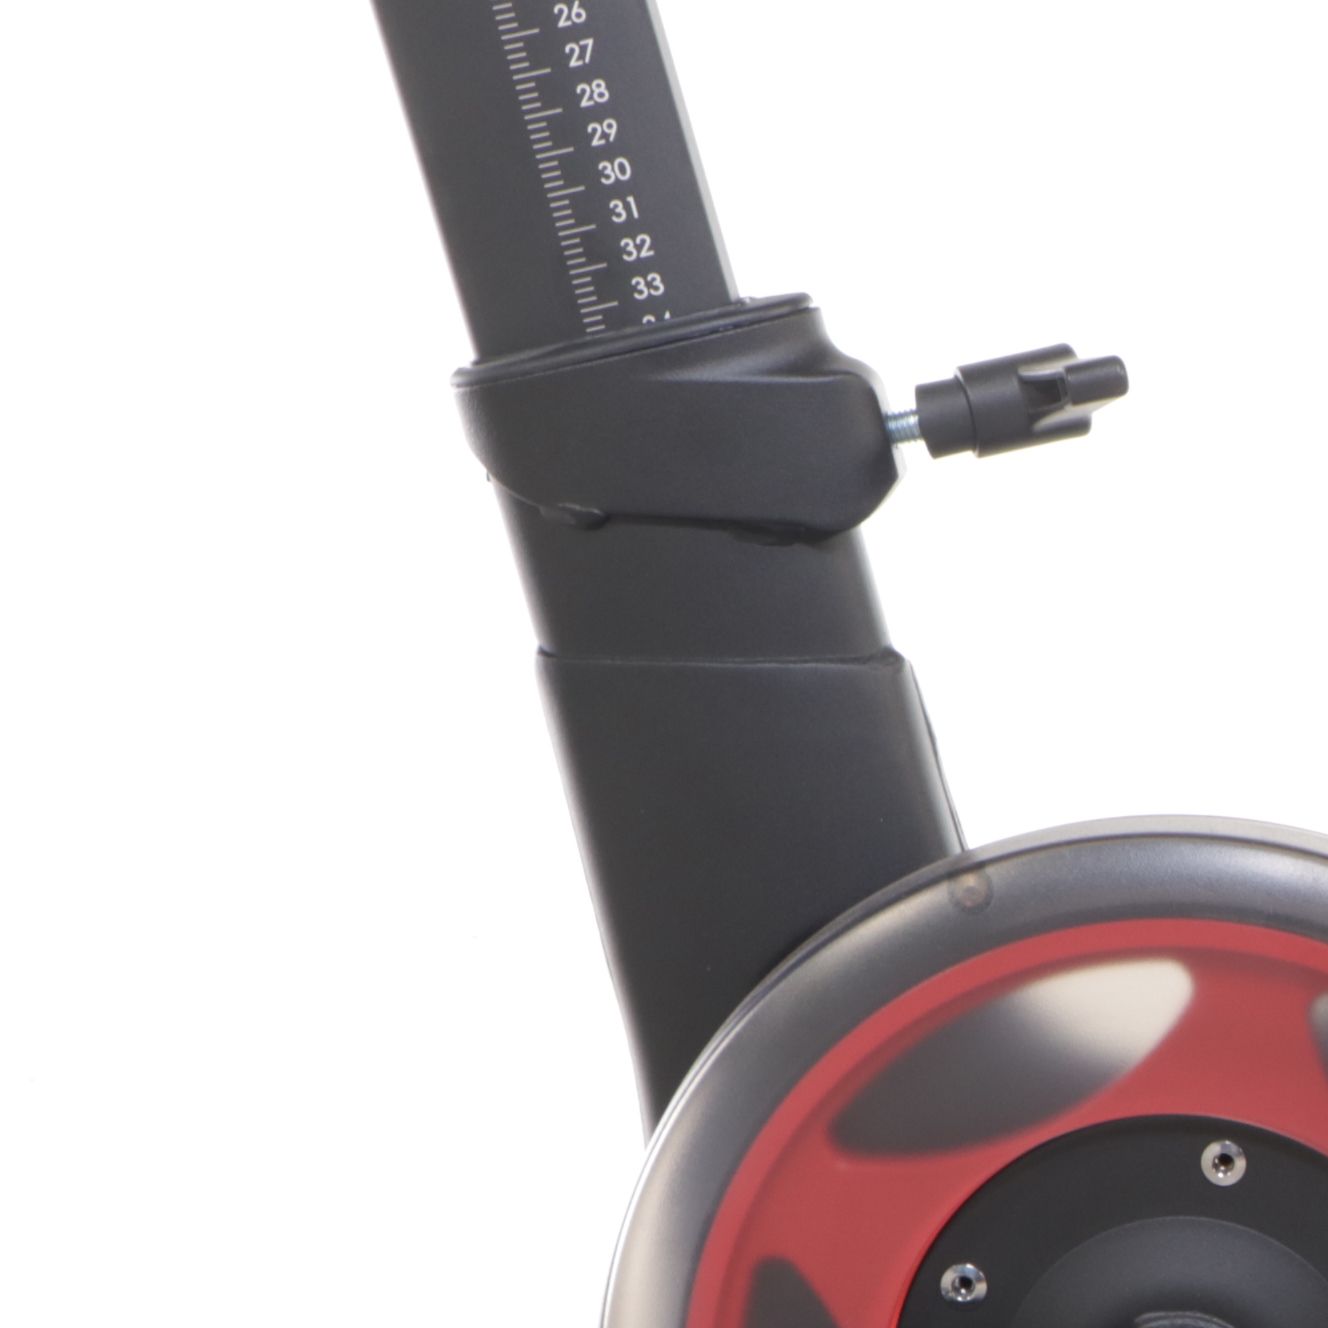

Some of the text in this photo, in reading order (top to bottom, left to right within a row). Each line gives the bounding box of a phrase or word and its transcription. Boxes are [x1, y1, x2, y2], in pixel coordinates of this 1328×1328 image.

[553, 0, 587, 28] 26
[565, 38, 594, 68] 27
[576, 78, 610, 108] 28
[587, 118, 618, 147] 29
[598, 157, 631, 185] 30
[609, 195, 639, 223] 31
[620, 233, 655, 262] 32
[631, 272, 665, 300] 33
